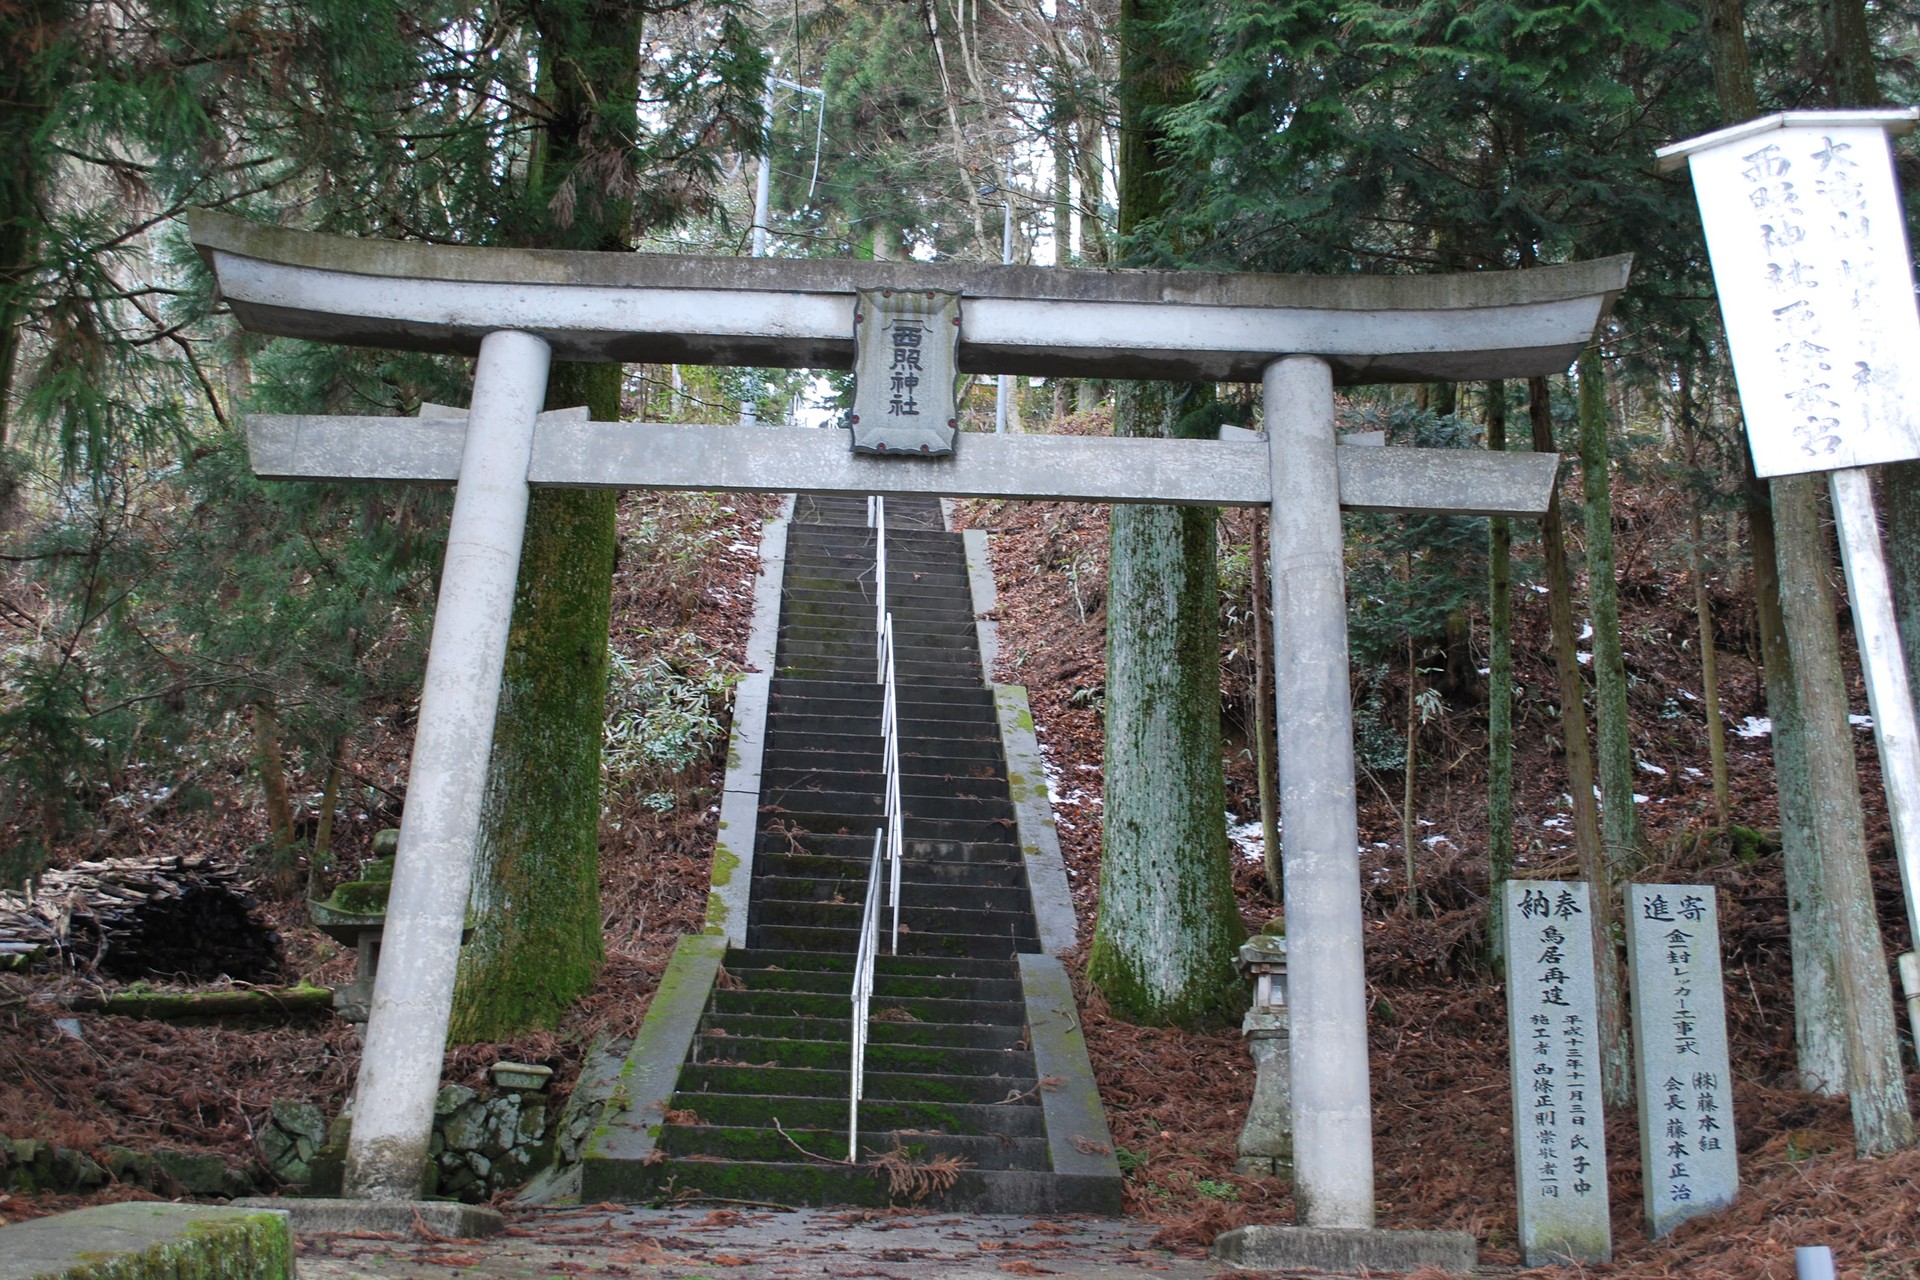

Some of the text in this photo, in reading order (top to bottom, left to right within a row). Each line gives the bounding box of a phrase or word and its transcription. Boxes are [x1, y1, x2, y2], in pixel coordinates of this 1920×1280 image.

[888, 326, 923, 416] 西照神社
[1537, 925, 1571, 1006] 鳥居再建
[1570, 1134, 1592, 1197] 氏子中
[1665, 1118, 1692, 1201] 藤本正治
